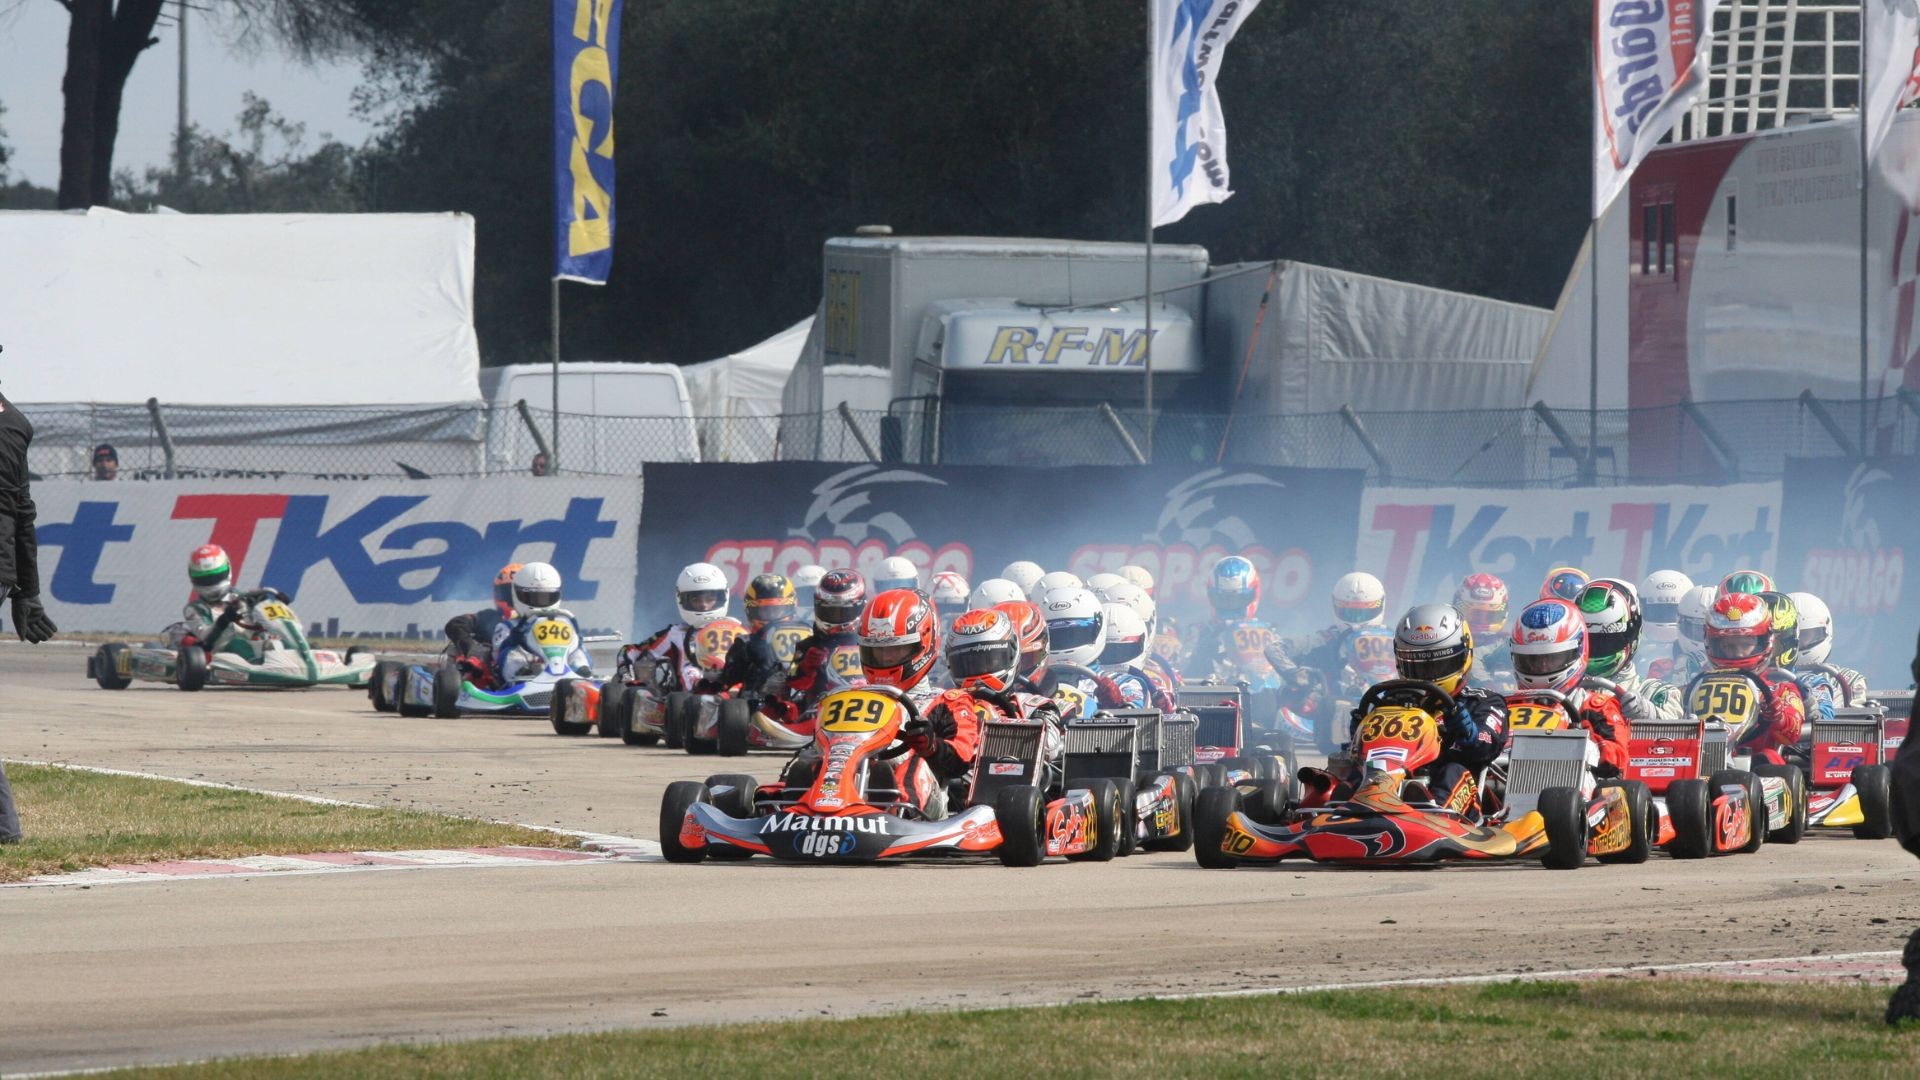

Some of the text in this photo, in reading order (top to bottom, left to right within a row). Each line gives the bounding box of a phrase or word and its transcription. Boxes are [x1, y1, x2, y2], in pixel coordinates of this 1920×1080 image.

[171, 494, 617, 605] TKart
[538, 625, 571, 640] 346
[962, 624, 985, 635] MAX
[1433, 648, 1454, 657] WINGS
[823, 698, 885, 727] 329
[1694, 683, 1747, 716] 356
[1362, 714, 1424, 743] 363
[759, 811, 891, 835] Matmut
